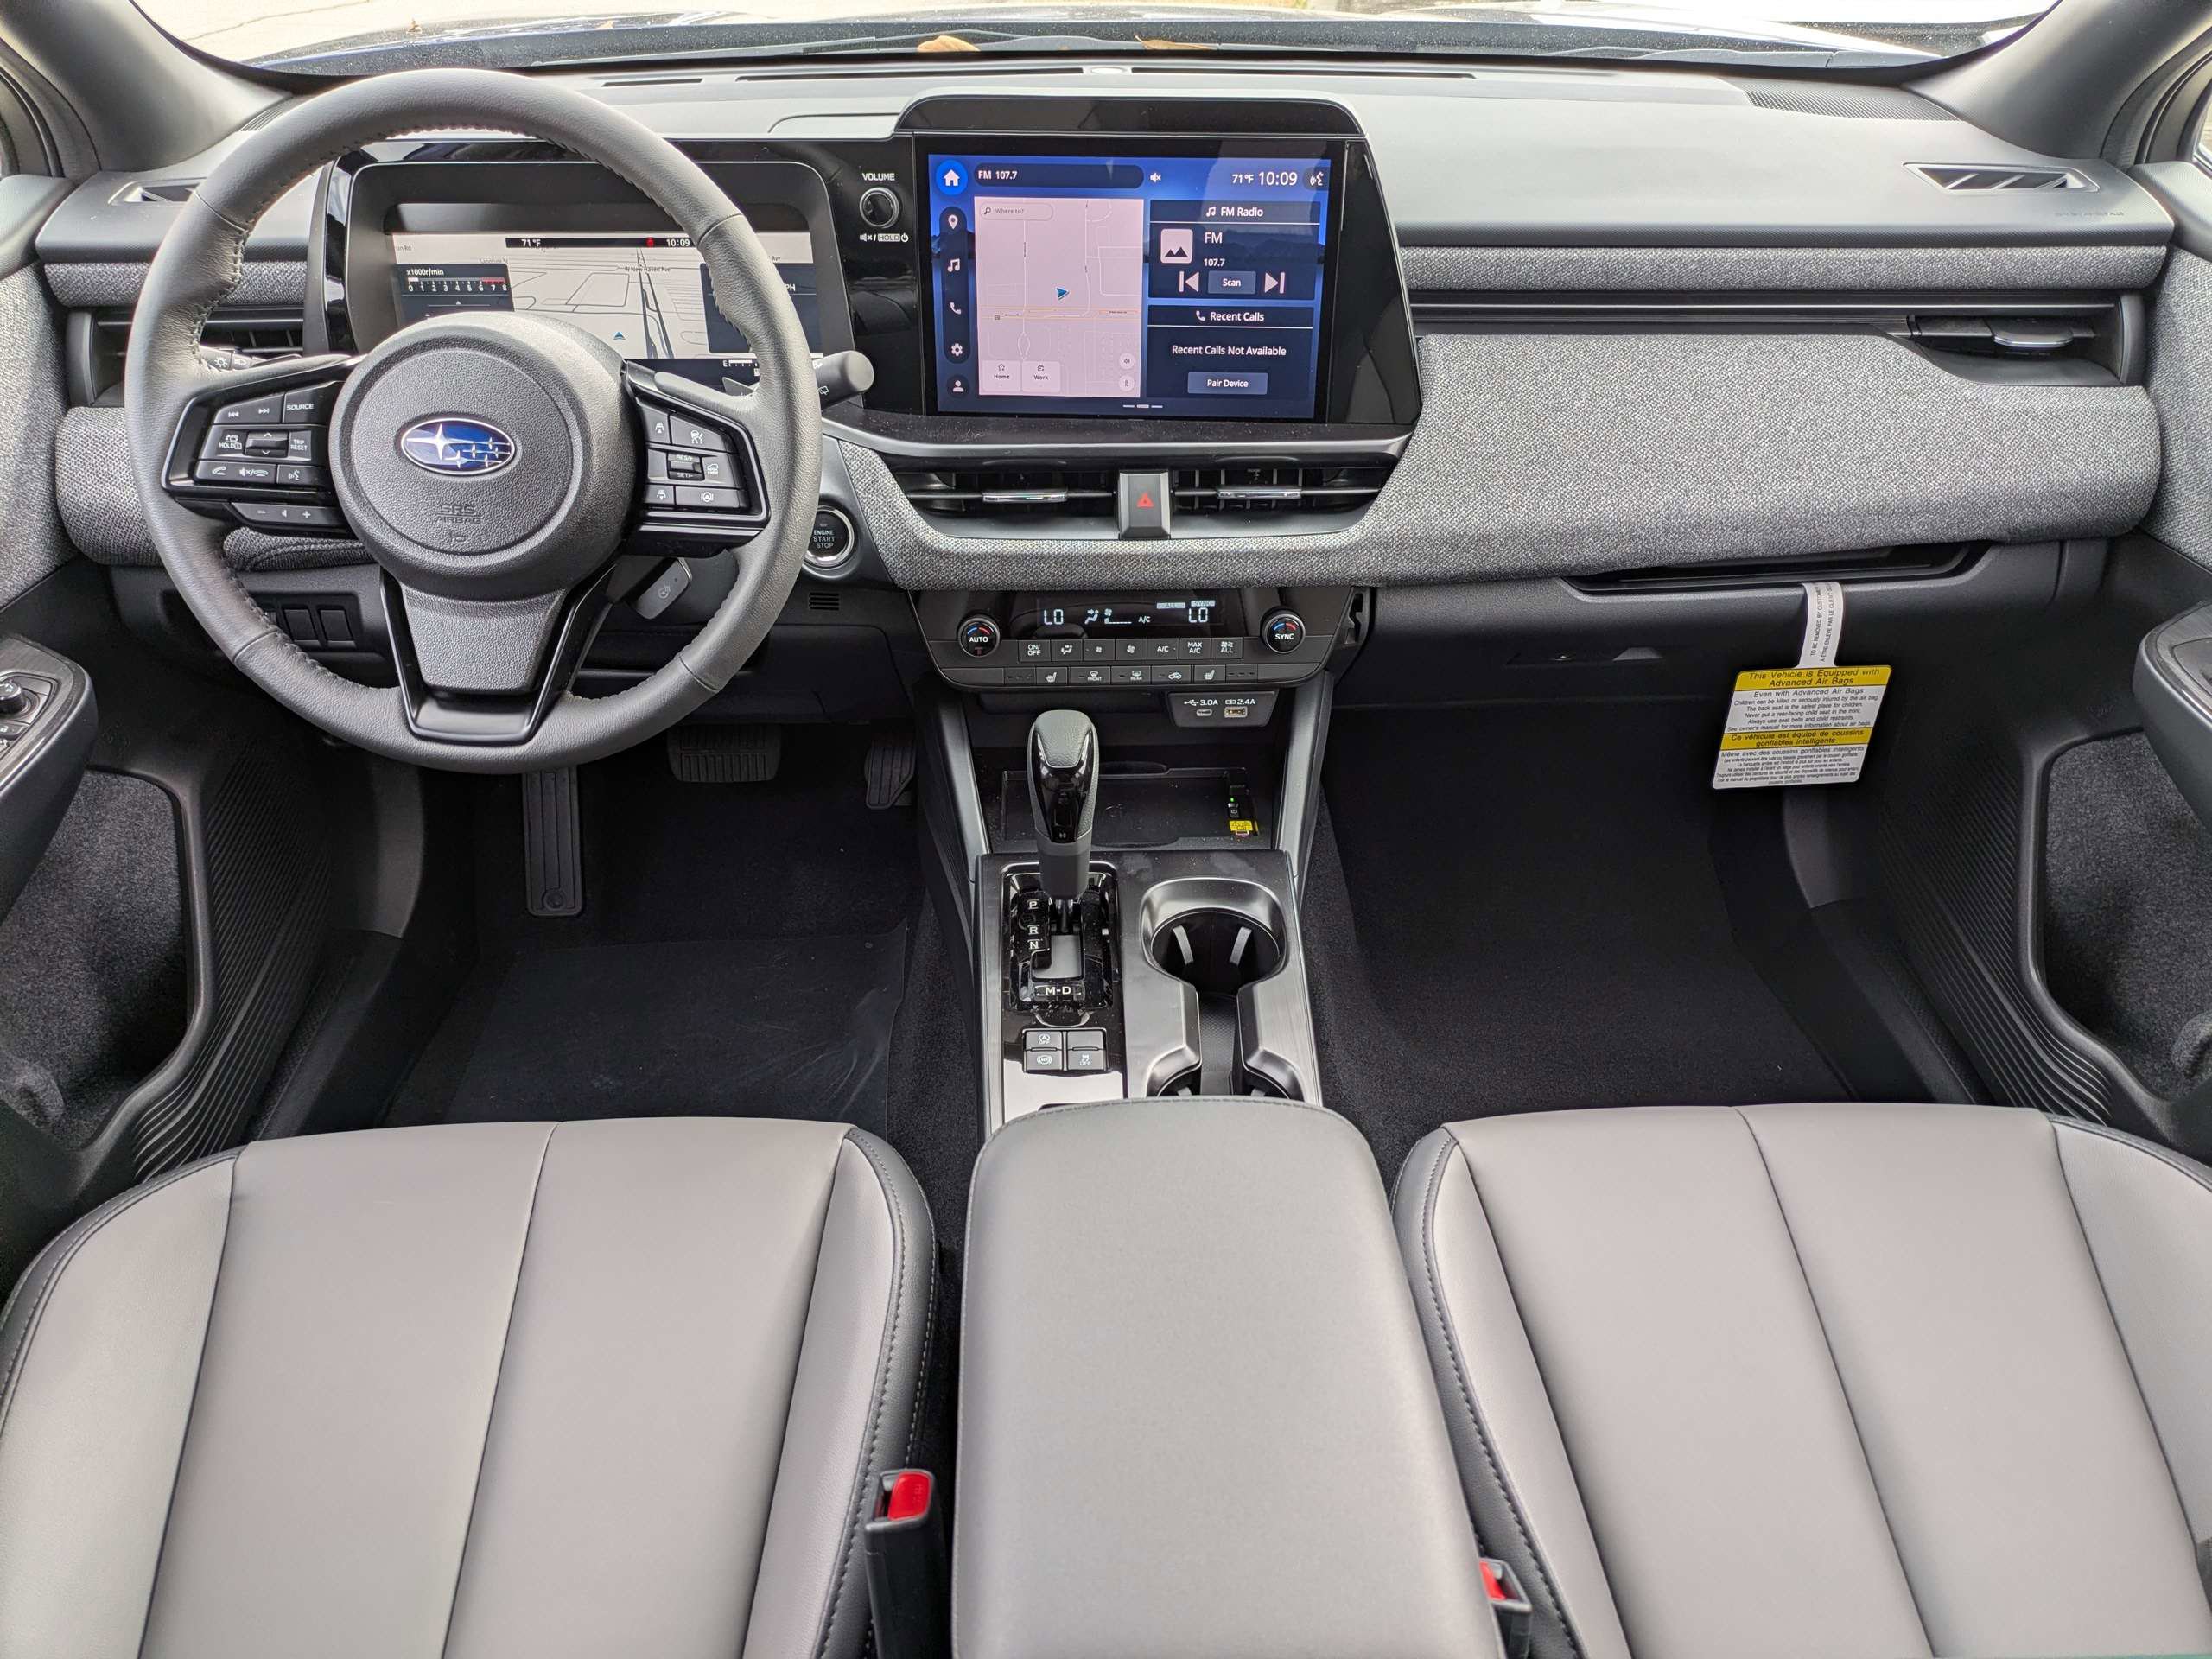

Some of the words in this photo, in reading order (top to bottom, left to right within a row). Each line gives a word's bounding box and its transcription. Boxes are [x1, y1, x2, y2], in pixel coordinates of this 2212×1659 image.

[978, 171, 992, 180] FM
[995, 171, 1018, 180] 107.7
[1232, 174, 1255, 184] 71°F
[1258, 171, 1298, 186] 10:09
[1220, 207, 1235, 216] FM
[1237, 207, 1263, 217] Radio
[666, 238, 690, 247] 10:09
[1205, 232, 1223, 244] FM
[1204, 258, 1225, 267] 107.7
[1223, 278, 1242, 287] Scan
[1210, 312, 1242, 321] Recent
[1243, 312, 1265, 321] Calls
[1172, 345, 1203, 355] Recent
[1205, 345, 1225, 355] Calls
[1228, 346, 1244, 355] Not
[1246, 346, 1287, 356] Available
[1224, 379, 1249, 388] Device
[440, 504, 476, 514] SRS
[1043, 609, 1064, 625] LO
[1188, 607, 1209, 623] LO
[1817, 669, 1859, 677] Equipped
[1769, 678, 1812, 687] Advanced
[1832, 677, 1853, 686] Bags
[1745, 732, 1775, 741] véhicule
[1792, 730, 1817, 739] équipé
[1756, 740, 1794, 748] gonflables
[1796, 737, 1837, 746] intelligents
[1030, 941, 1039, 950] N
